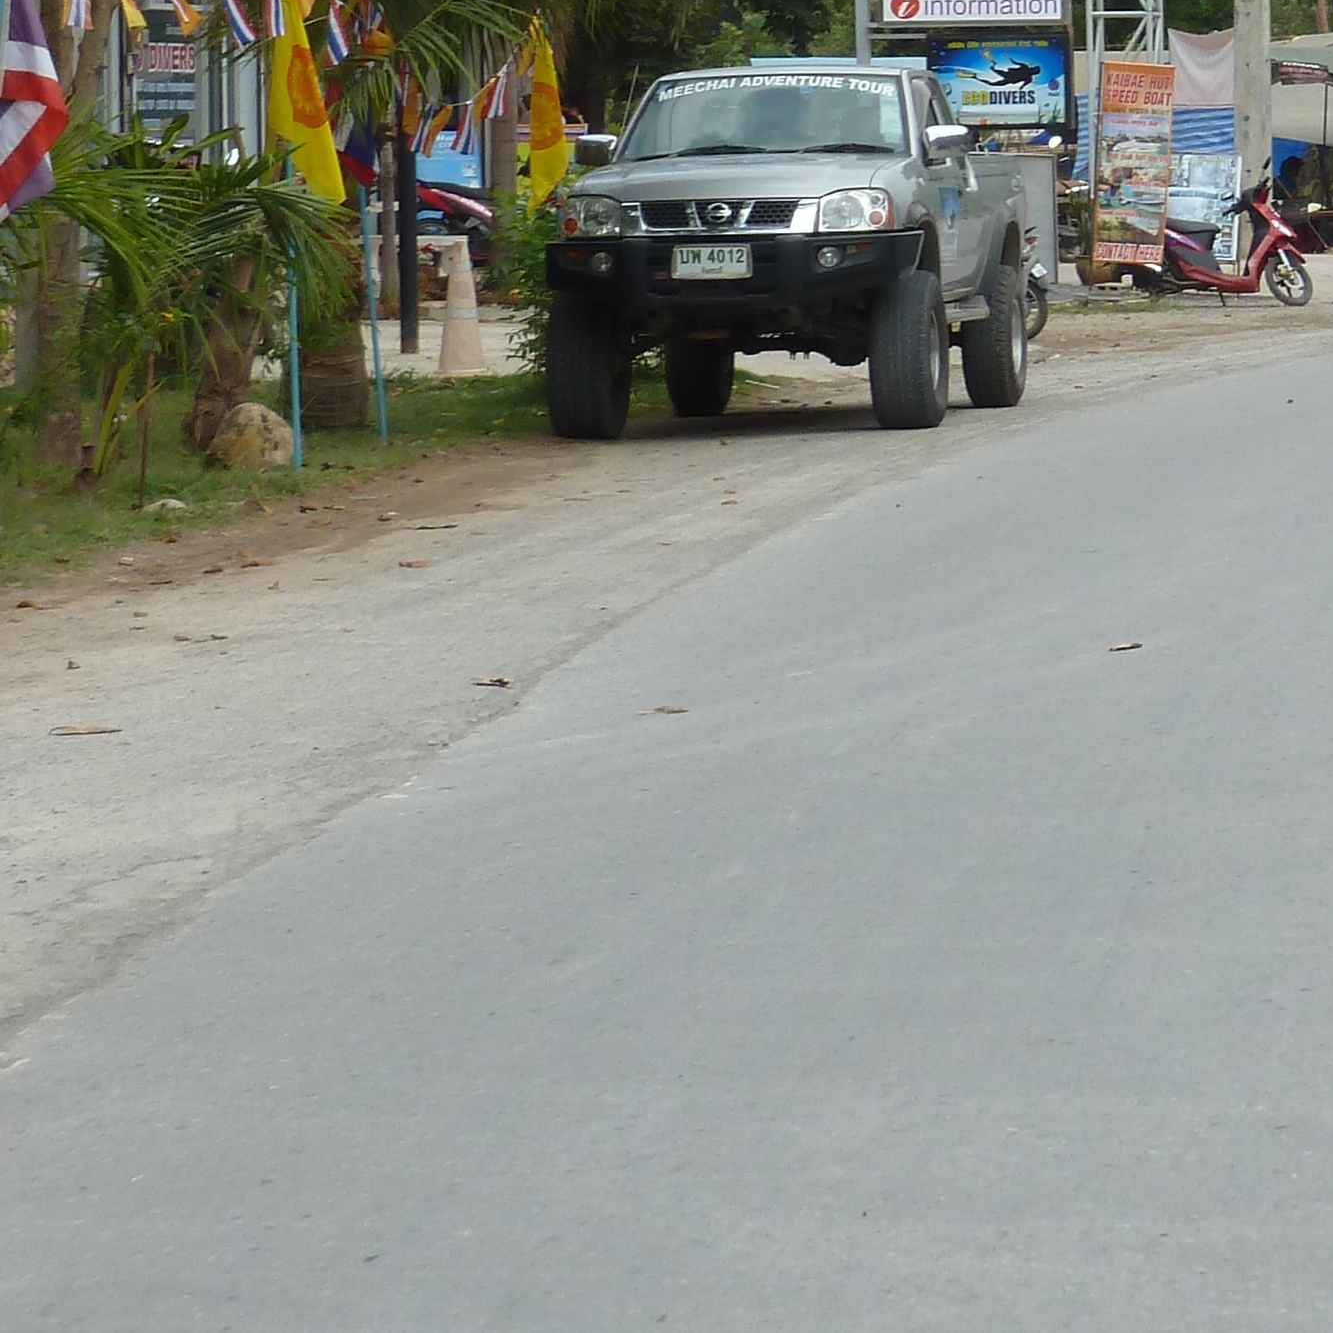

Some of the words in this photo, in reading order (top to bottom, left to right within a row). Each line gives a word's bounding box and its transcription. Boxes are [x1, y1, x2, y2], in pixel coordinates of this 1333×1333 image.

[148, 44, 196, 72] DIVERS
[657, 79, 736, 103] MEECHAI
[739, 74, 844, 89] ADVENTURE
[848, 78, 897, 98] TOUR
[1106, 73, 1146, 88] KAIBAE
[1149, 76, 1172, 89] HUT
[1105, 89, 1139, 104] SPEED
[1143, 91, 1173, 106] BOAT
[707, 248, 745, 264] 4012
[1096, 242, 1137, 259] CONTACT
[1138, 244, 1163, 261] HERE
